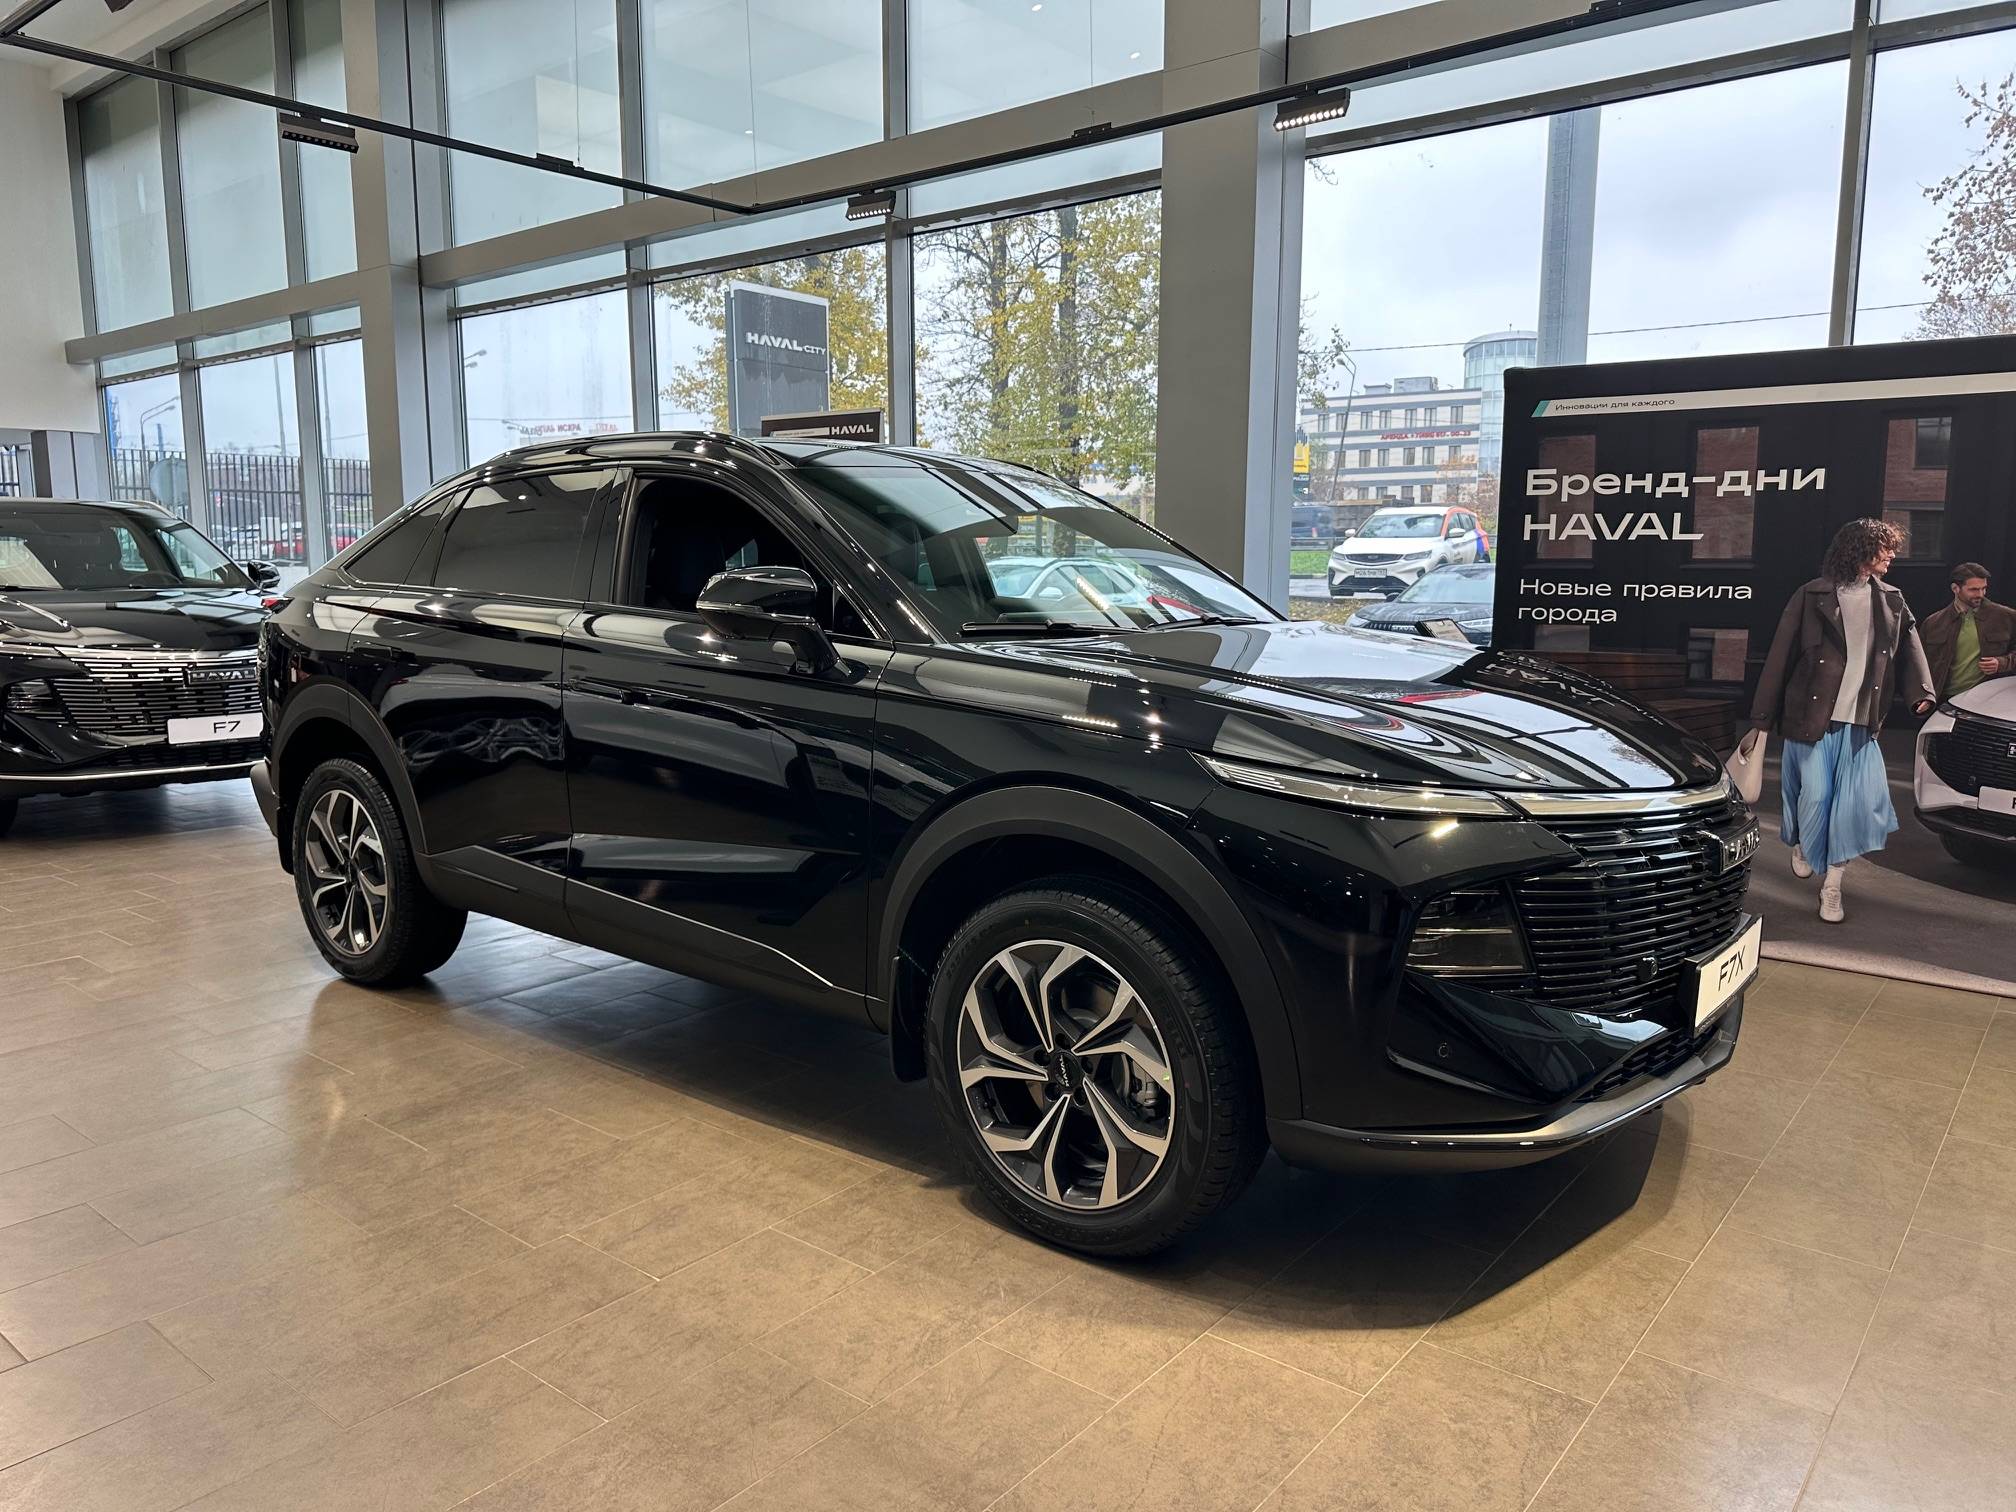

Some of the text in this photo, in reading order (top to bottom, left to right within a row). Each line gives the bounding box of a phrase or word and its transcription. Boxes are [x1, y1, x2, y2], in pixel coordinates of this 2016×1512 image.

[745, 332, 827, 355] HAVAL CITY
[1555, 399, 1676, 411] Инновации для каждого
[831, 424, 874, 435] HAVAL
[1526, 468, 1826, 502] Бренд-дни
[1523, 512, 1705, 541] HAVAL
[1519, 578, 1752, 602] Новые правила
[1518, 606, 1617, 625] города
[192, 670, 255, 680] HAVAL
[213, 720, 241, 734] F7
[1718, 944, 1746, 992] F7X
